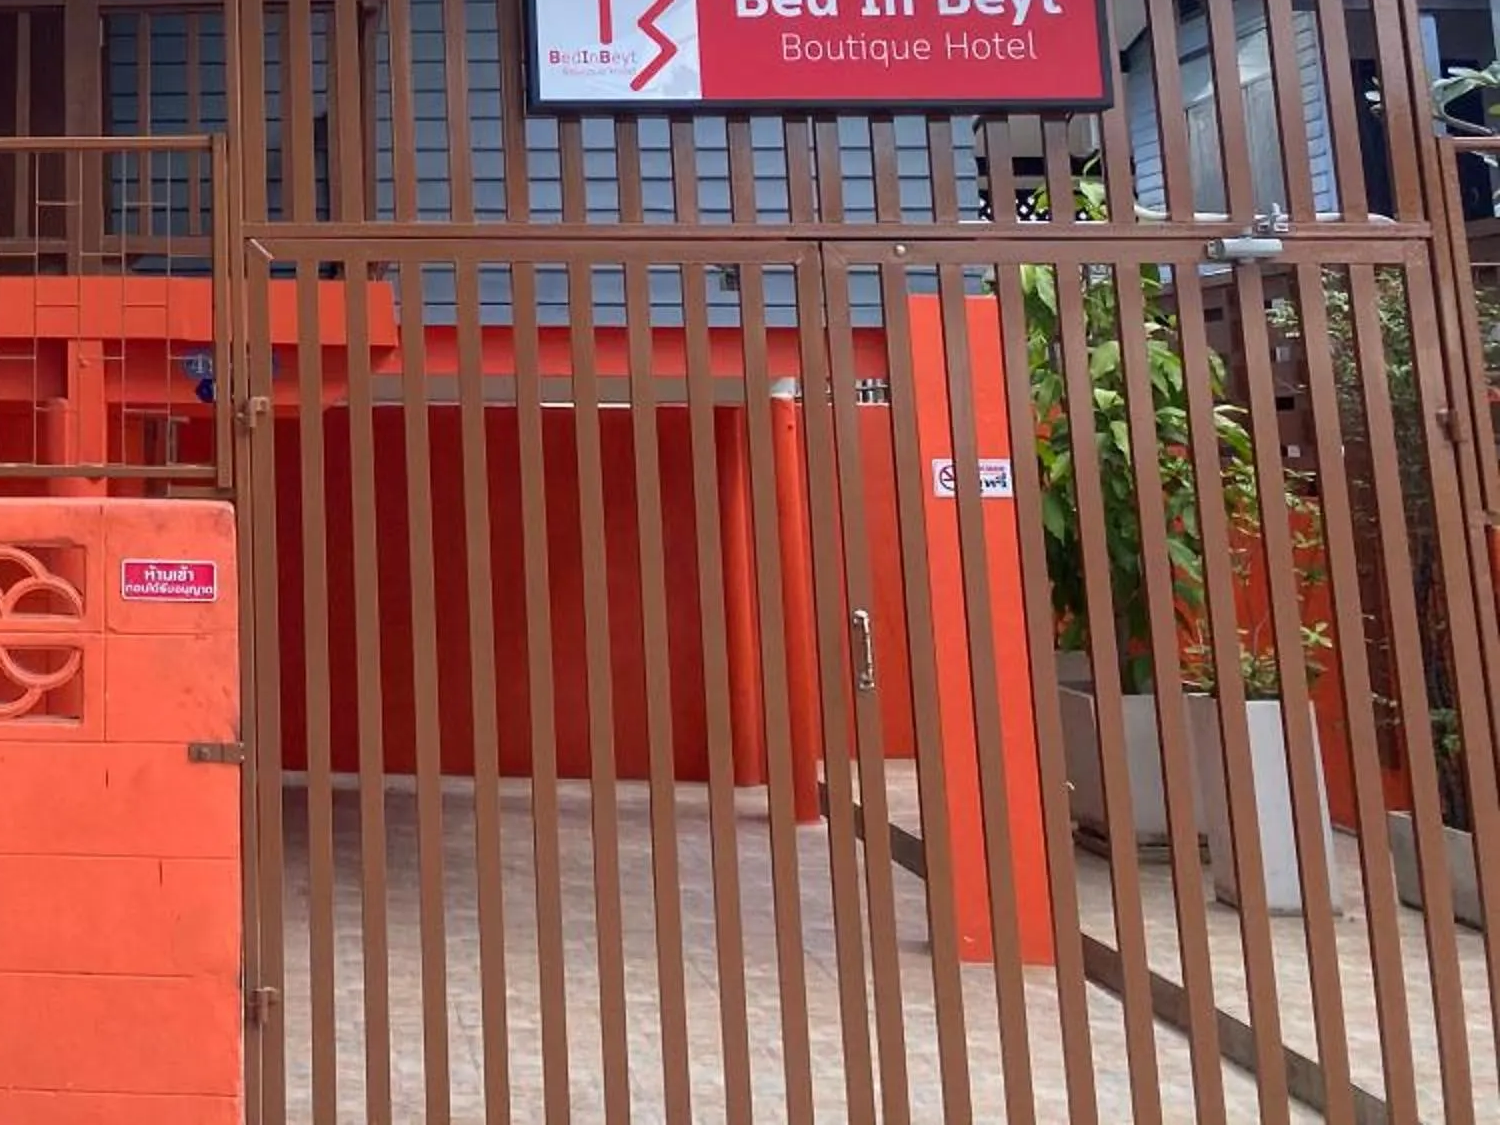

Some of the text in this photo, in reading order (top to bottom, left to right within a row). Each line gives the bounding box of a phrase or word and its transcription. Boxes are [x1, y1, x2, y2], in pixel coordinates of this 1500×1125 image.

[781, 29, 1038, 68] Boutique Hotel
[144, 565, 194, 581] ห้ามเข้า
